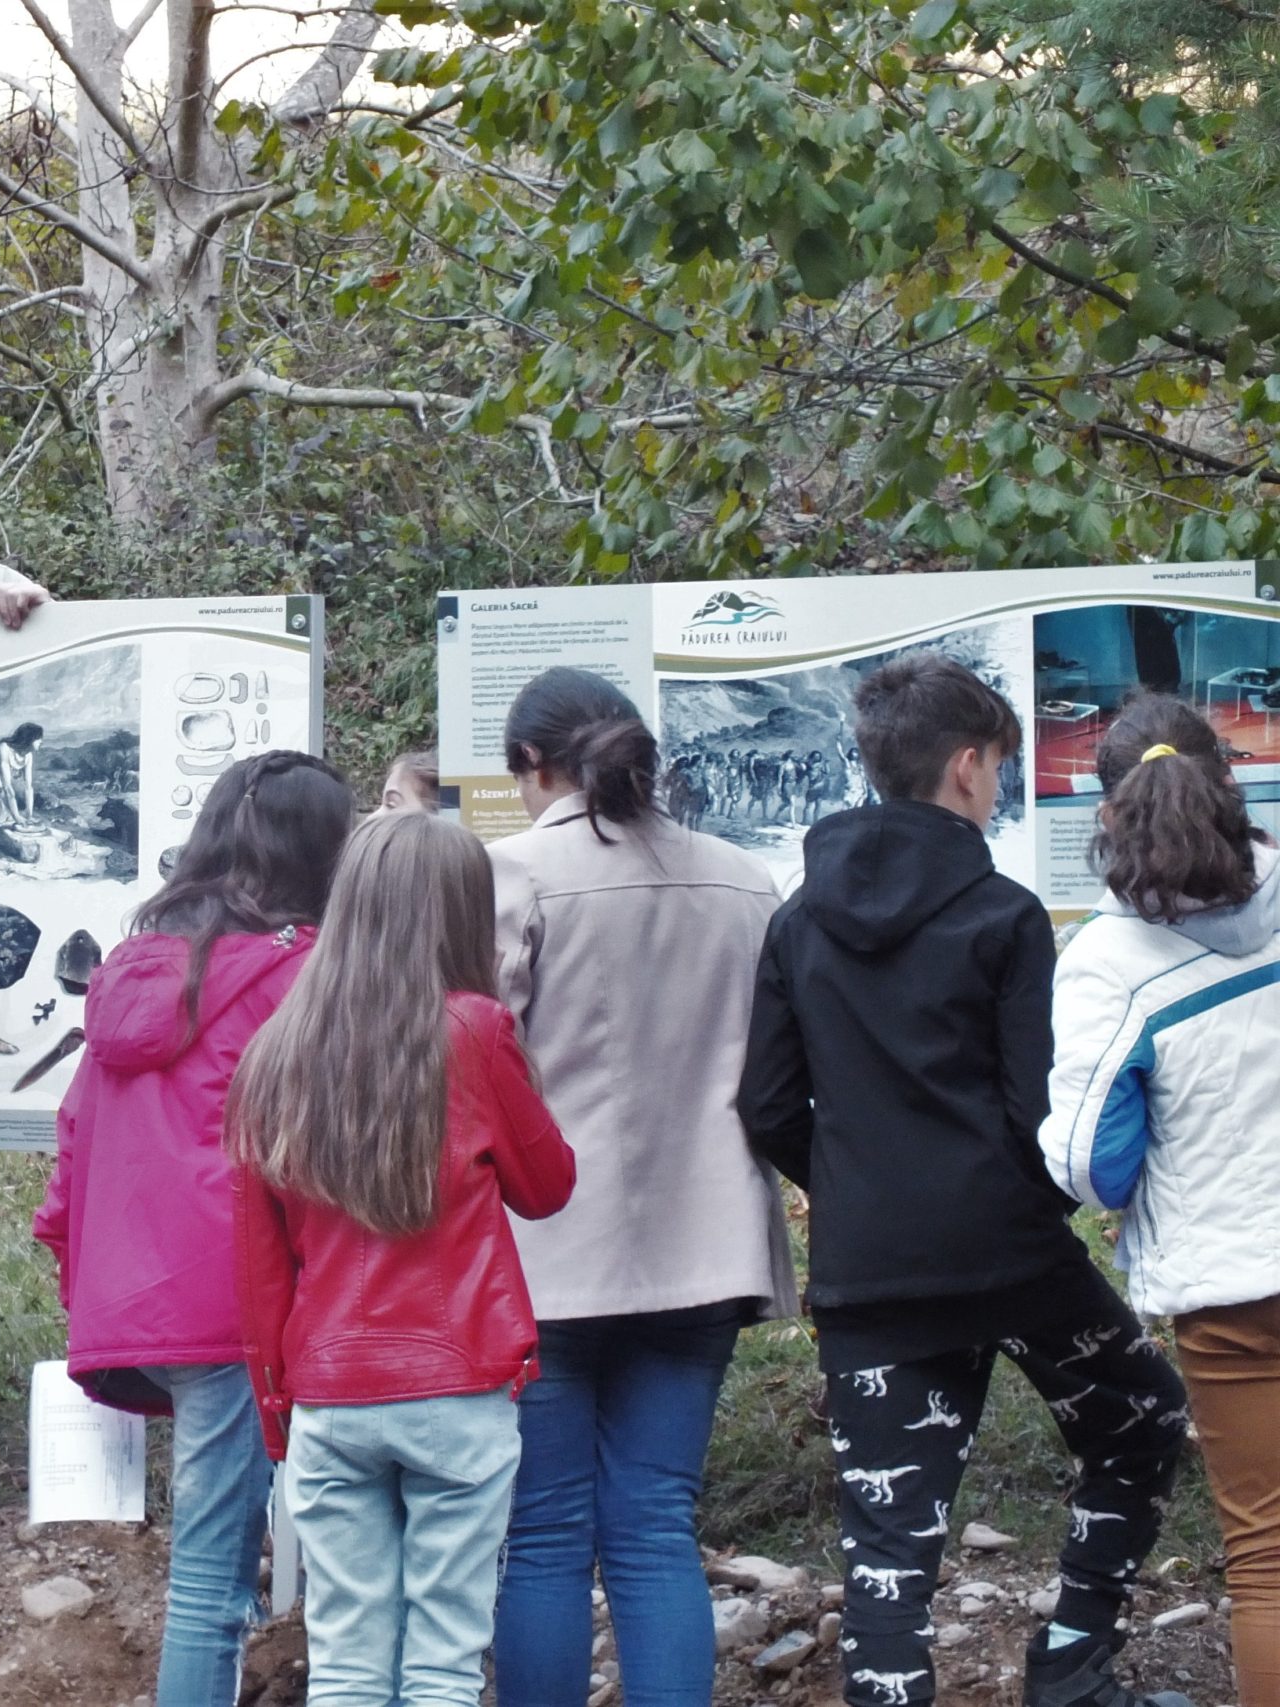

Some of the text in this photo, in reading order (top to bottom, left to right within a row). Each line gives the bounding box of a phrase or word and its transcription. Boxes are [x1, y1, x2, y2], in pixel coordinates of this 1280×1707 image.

[1152, 569, 1252, 580] www.padureacraiului.ro
[198, 606, 283, 615] www.padureacraiului.ro
[681, 629, 788, 646] PĂDUREA CRAIULUI
